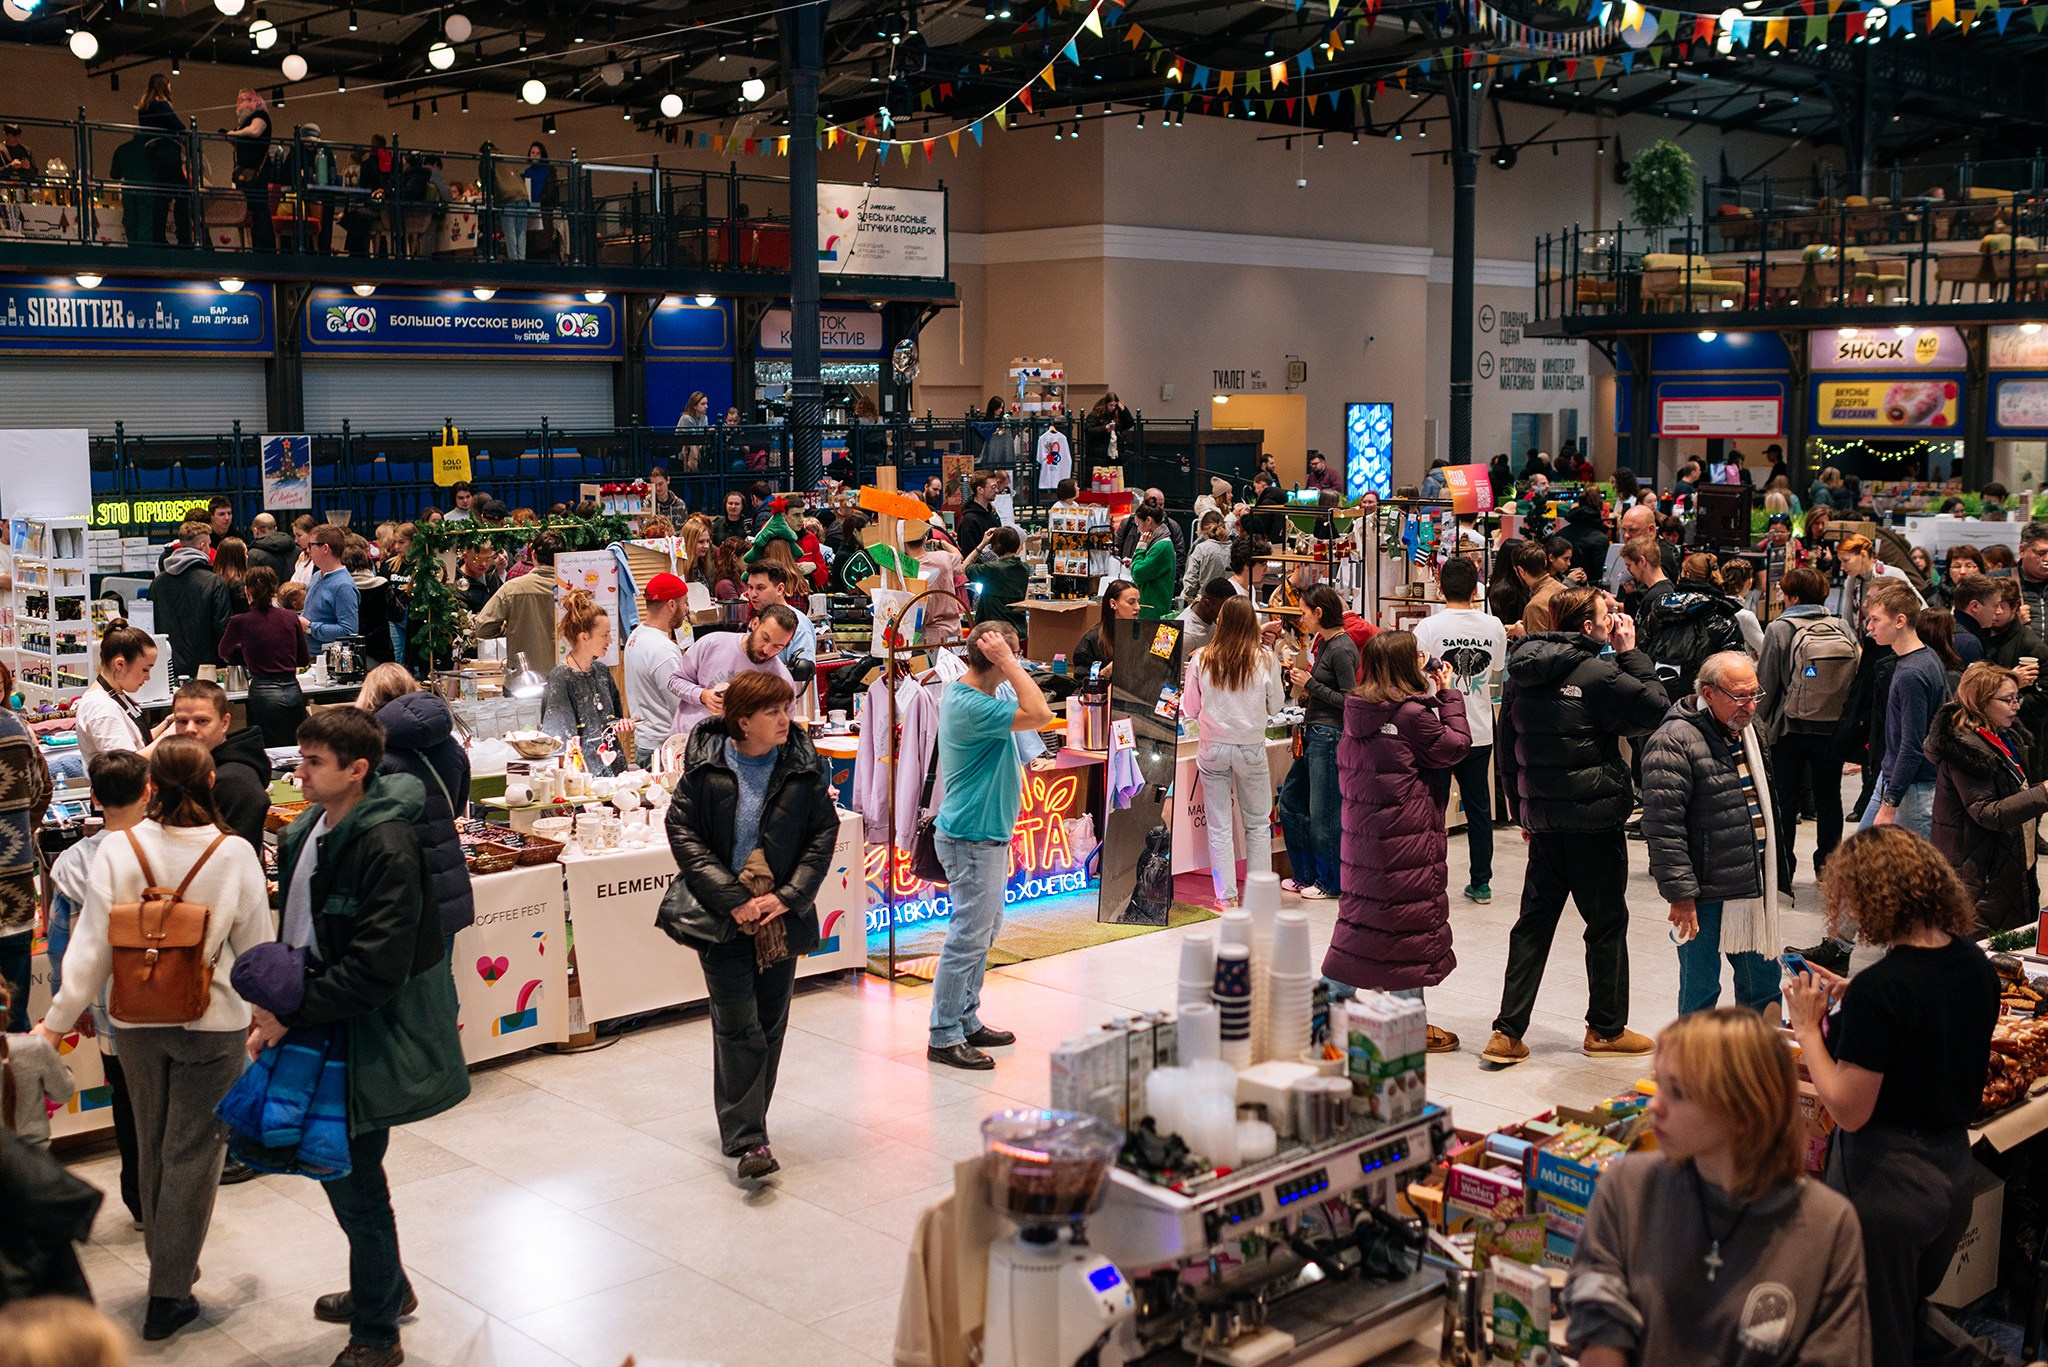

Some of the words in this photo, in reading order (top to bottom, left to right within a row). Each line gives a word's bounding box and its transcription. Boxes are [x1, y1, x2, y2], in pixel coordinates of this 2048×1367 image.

[857, 212, 884, 222] ЗДЕСЬ
[885, 213, 927, 224] КЛАССНЫЕ
[858, 223, 892, 233] ШТУЧКИ
[900, 225, 937, 235] ПОДАРОК
[28, 297, 125, 329] SIBBITTER
[210, 306, 228, 315] БАР
[192, 315, 211, 324] ДЛЯ
[214, 315, 249, 325] ДРУЗЕЙ
[390, 315, 452, 328] БОЛЬШОЕ
[454, 316, 509, 329] РУССКОЕ
[511, 318, 544, 329] ВИНО
[514, 333, 522, 341] by
[523, 330, 550, 342] simple
[780, 330, 865, 345] КЕКТИВ
[1500, 329, 1520, 346] СЦЕНА
[1918, 338, 1937, 348] NO
[1839, 339, 1904, 359] SHOCK
[1500, 357, 1536, 373] РЕСТОРАНЫ
[1542, 358, 1575, 373] КИНОТЕАТР
[1213, 370, 1245, 389] ТУАЛЕТ
[1500, 375, 1535, 390] МАГАЗИНЫ
[1542, 375, 1564, 390] МАЛАЯ
[1566, 375, 1585, 393] СЦЕНА
[1835, 388, 1870, 397] ВКУСНЫЕ
[1834, 398, 1868, 407] ДЕСЕРТЫ
[1832, 409, 1846, 419] БЕЗ
[97, 502, 130, 526] ЭТО
[1442, 638, 1492, 647] SANGALAI
[1017, 868, 1087, 900] ХОЧЕТСЯ!
[476, 907, 519, 927] COFFEE
[521, 902, 547, 918] FEST
[1540, 1167, 1590, 1196] MUESLI
[1460, 1180, 1495, 1201] Wafers
